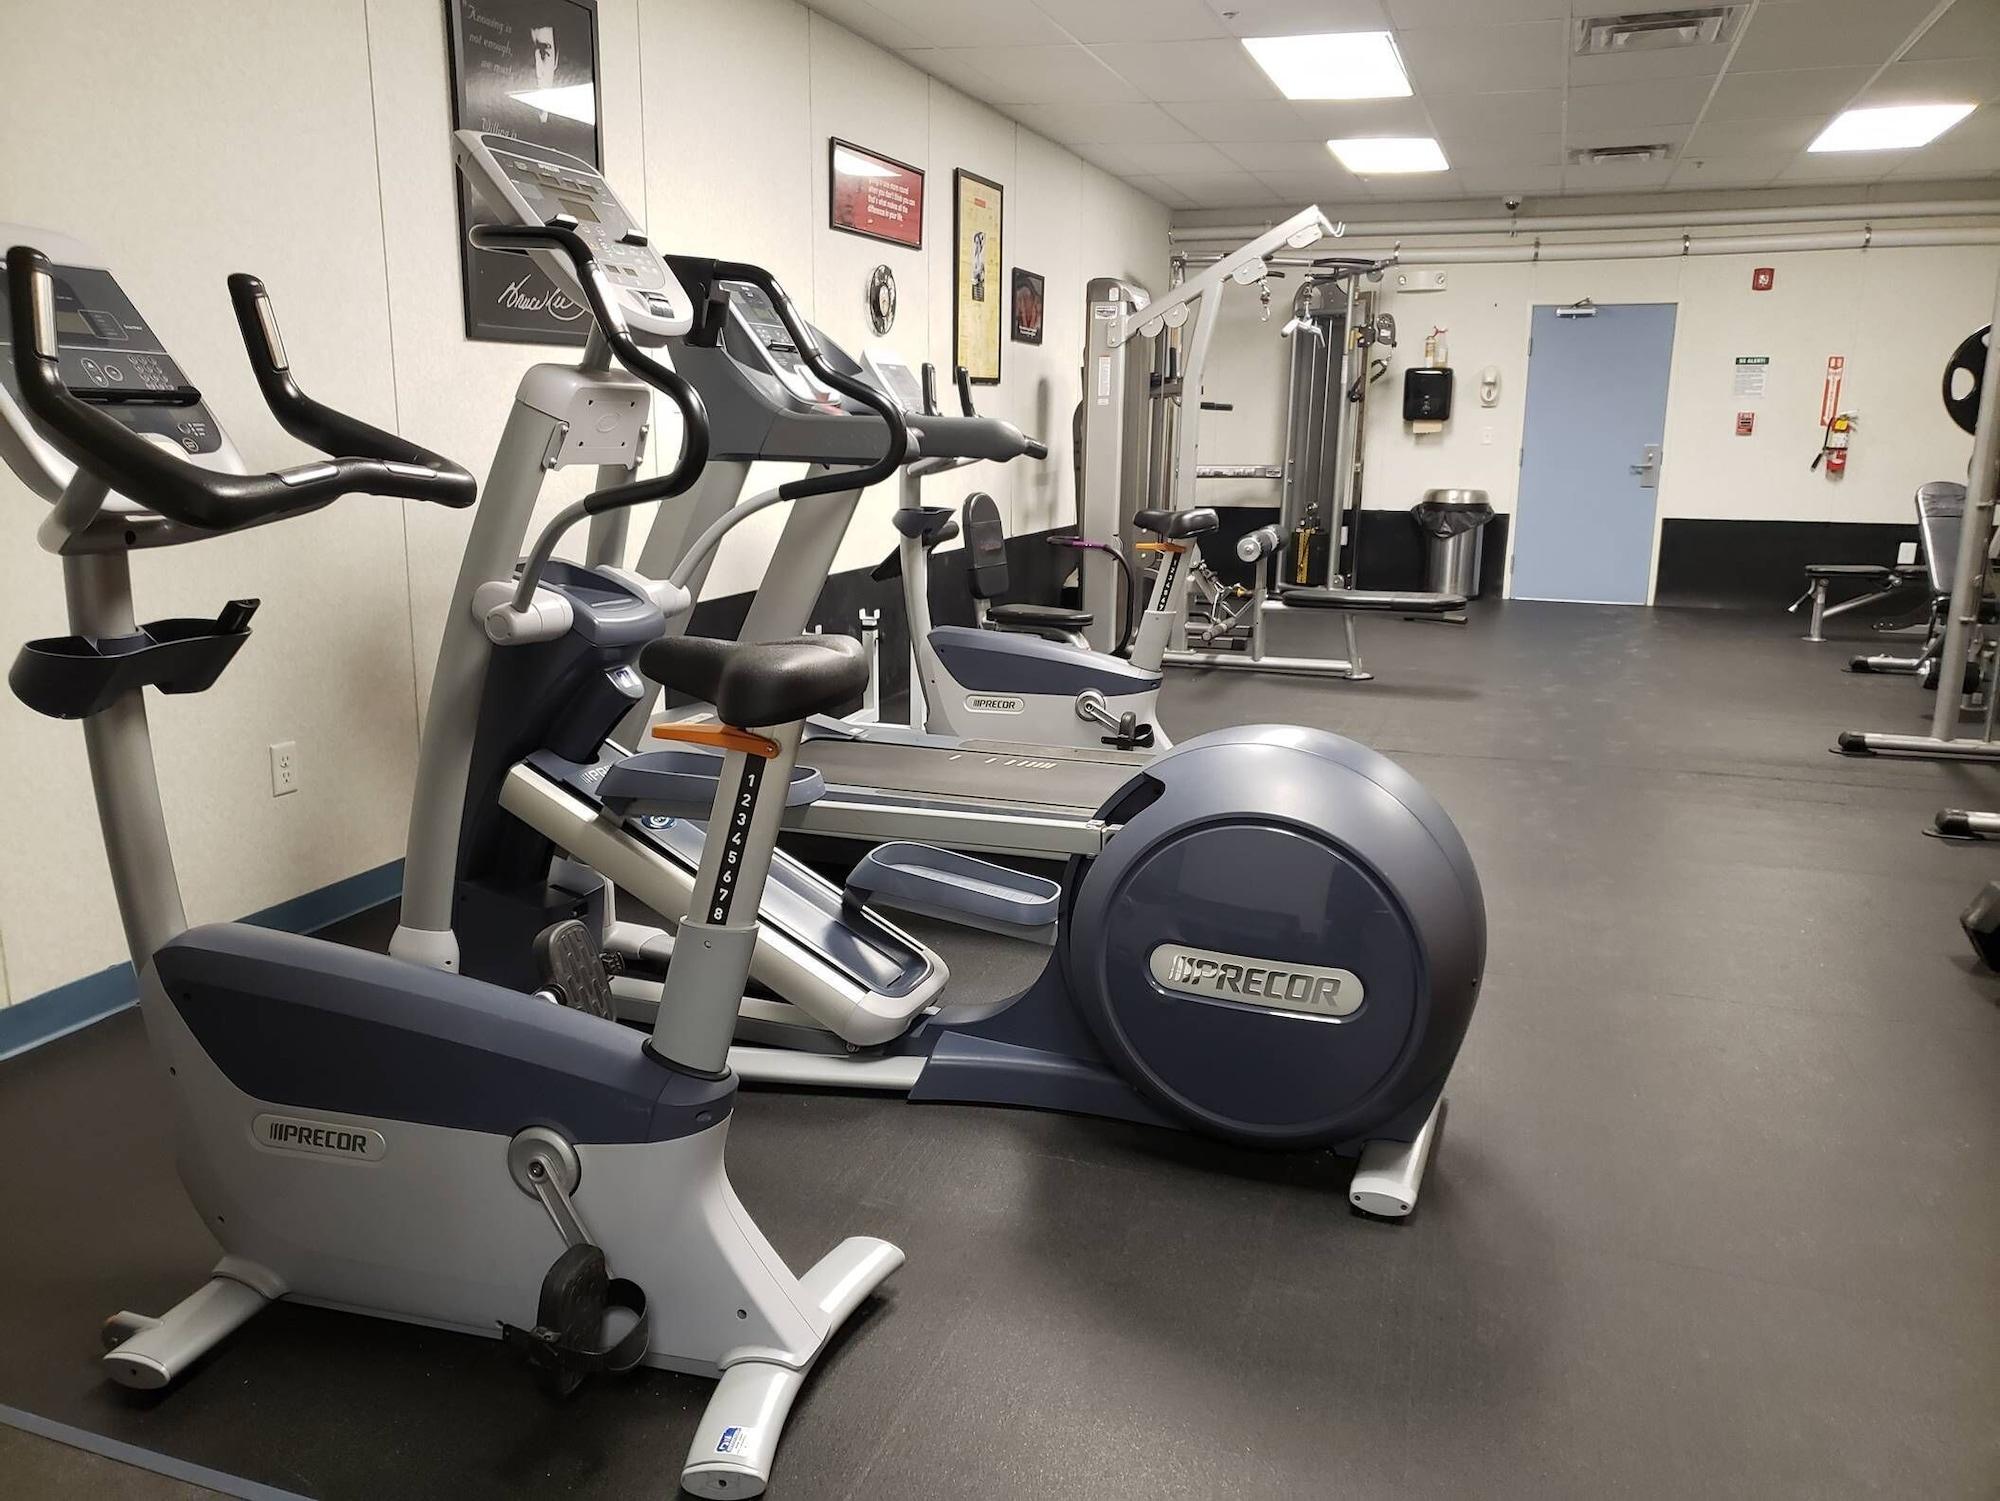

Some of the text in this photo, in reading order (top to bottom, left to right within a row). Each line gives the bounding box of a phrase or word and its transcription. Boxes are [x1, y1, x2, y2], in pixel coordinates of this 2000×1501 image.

[979, 699, 1016, 710] PRECOR
[748, 774, 755, 787] 1
[741, 793, 751, 807] 2
[736, 812, 746, 826] 3
[731, 832, 742, 845] 4
[727, 850, 738, 864] 5
[722, 870, 732, 883] 6
[719, 888, 729, 901] 7
[713, 907, 723, 920] 8
[1192, 959, 1342, 1007] PRECOR
[283, 1123, 367, 1153] PRECOR
